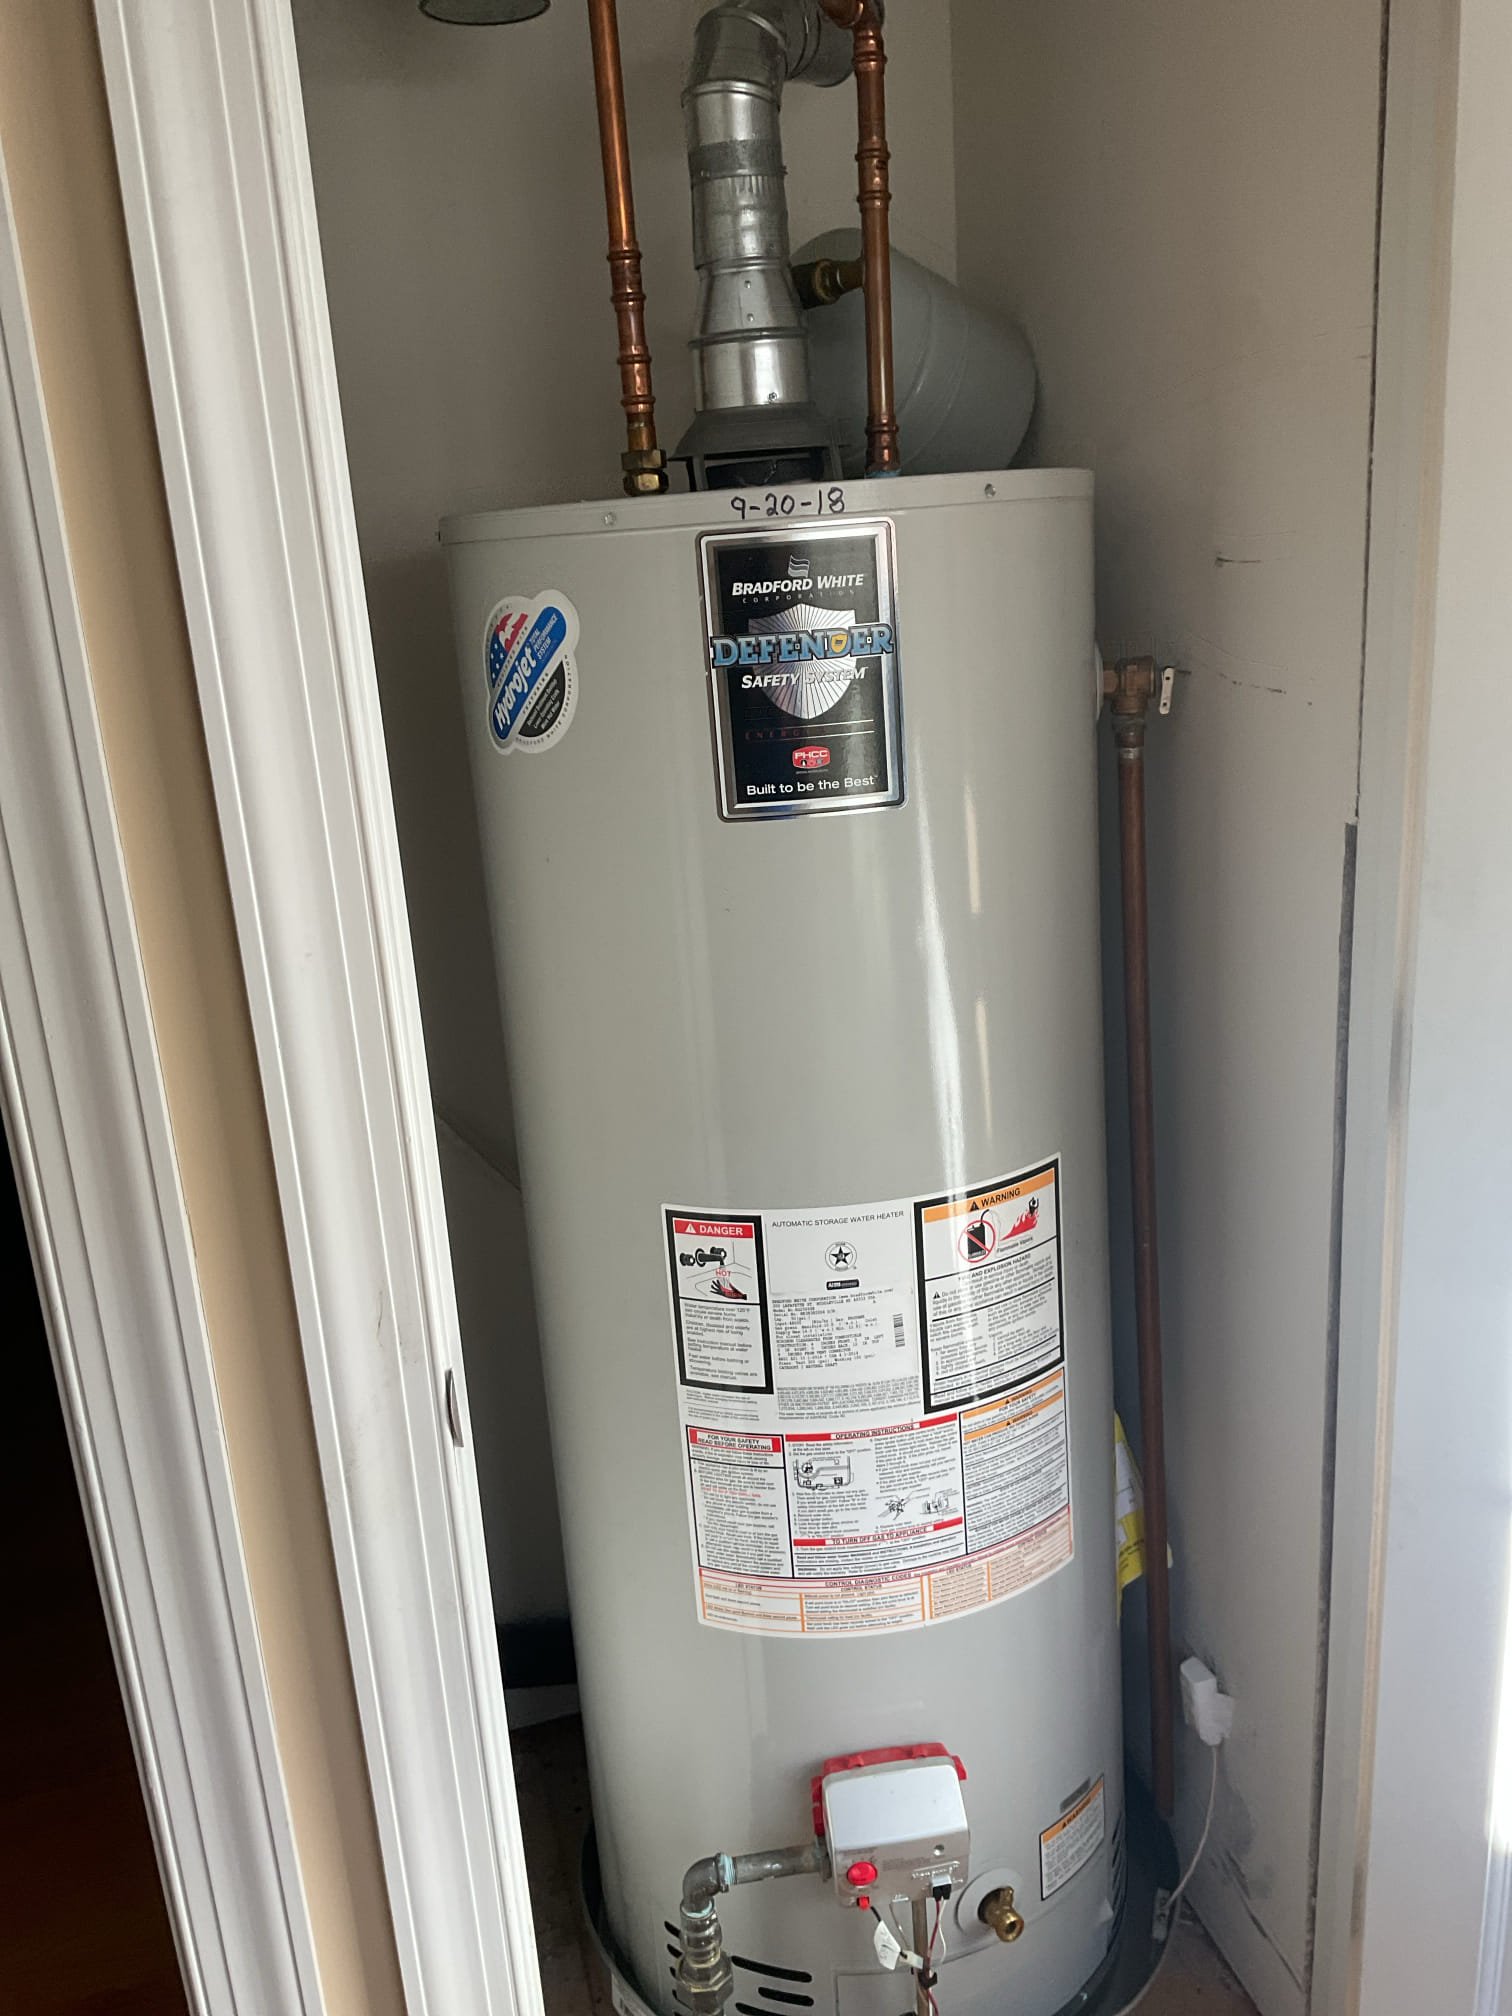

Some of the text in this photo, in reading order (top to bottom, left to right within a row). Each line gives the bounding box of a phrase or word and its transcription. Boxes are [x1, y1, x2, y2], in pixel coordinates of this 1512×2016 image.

[731, 487, 846, 519] 9-20-18
[732, 573, 865, 596] BRADFORD WHITE
[712, 623, 894, 668] DEFENDER
[741, 667, 866, 689] SAFETY SYSTEM
[494, 646, 538, 730] Hydrojet
[794, 749, 828, 759] PHCC
[747, 775, 875, 796] Built to be the Best
[981, 1187, 1021, 1207] WARNING
[772, 1210, 904, 1228] AUTOMATIC STORAGE WATER HEATER
[699, 1224, 744, 1236] DANGER
[715, 1268, 732, 1278] HOT
[971, 1270, 983, 1278] AND
[737, 1437, 760, 1445] SAFETY
[835, 1424, 914, 1440] OPERATING INSTRUCTIONS
[872, 1534, 885, 1542] GAS
[895, 1527, 928, 1538] APPLIANCE
